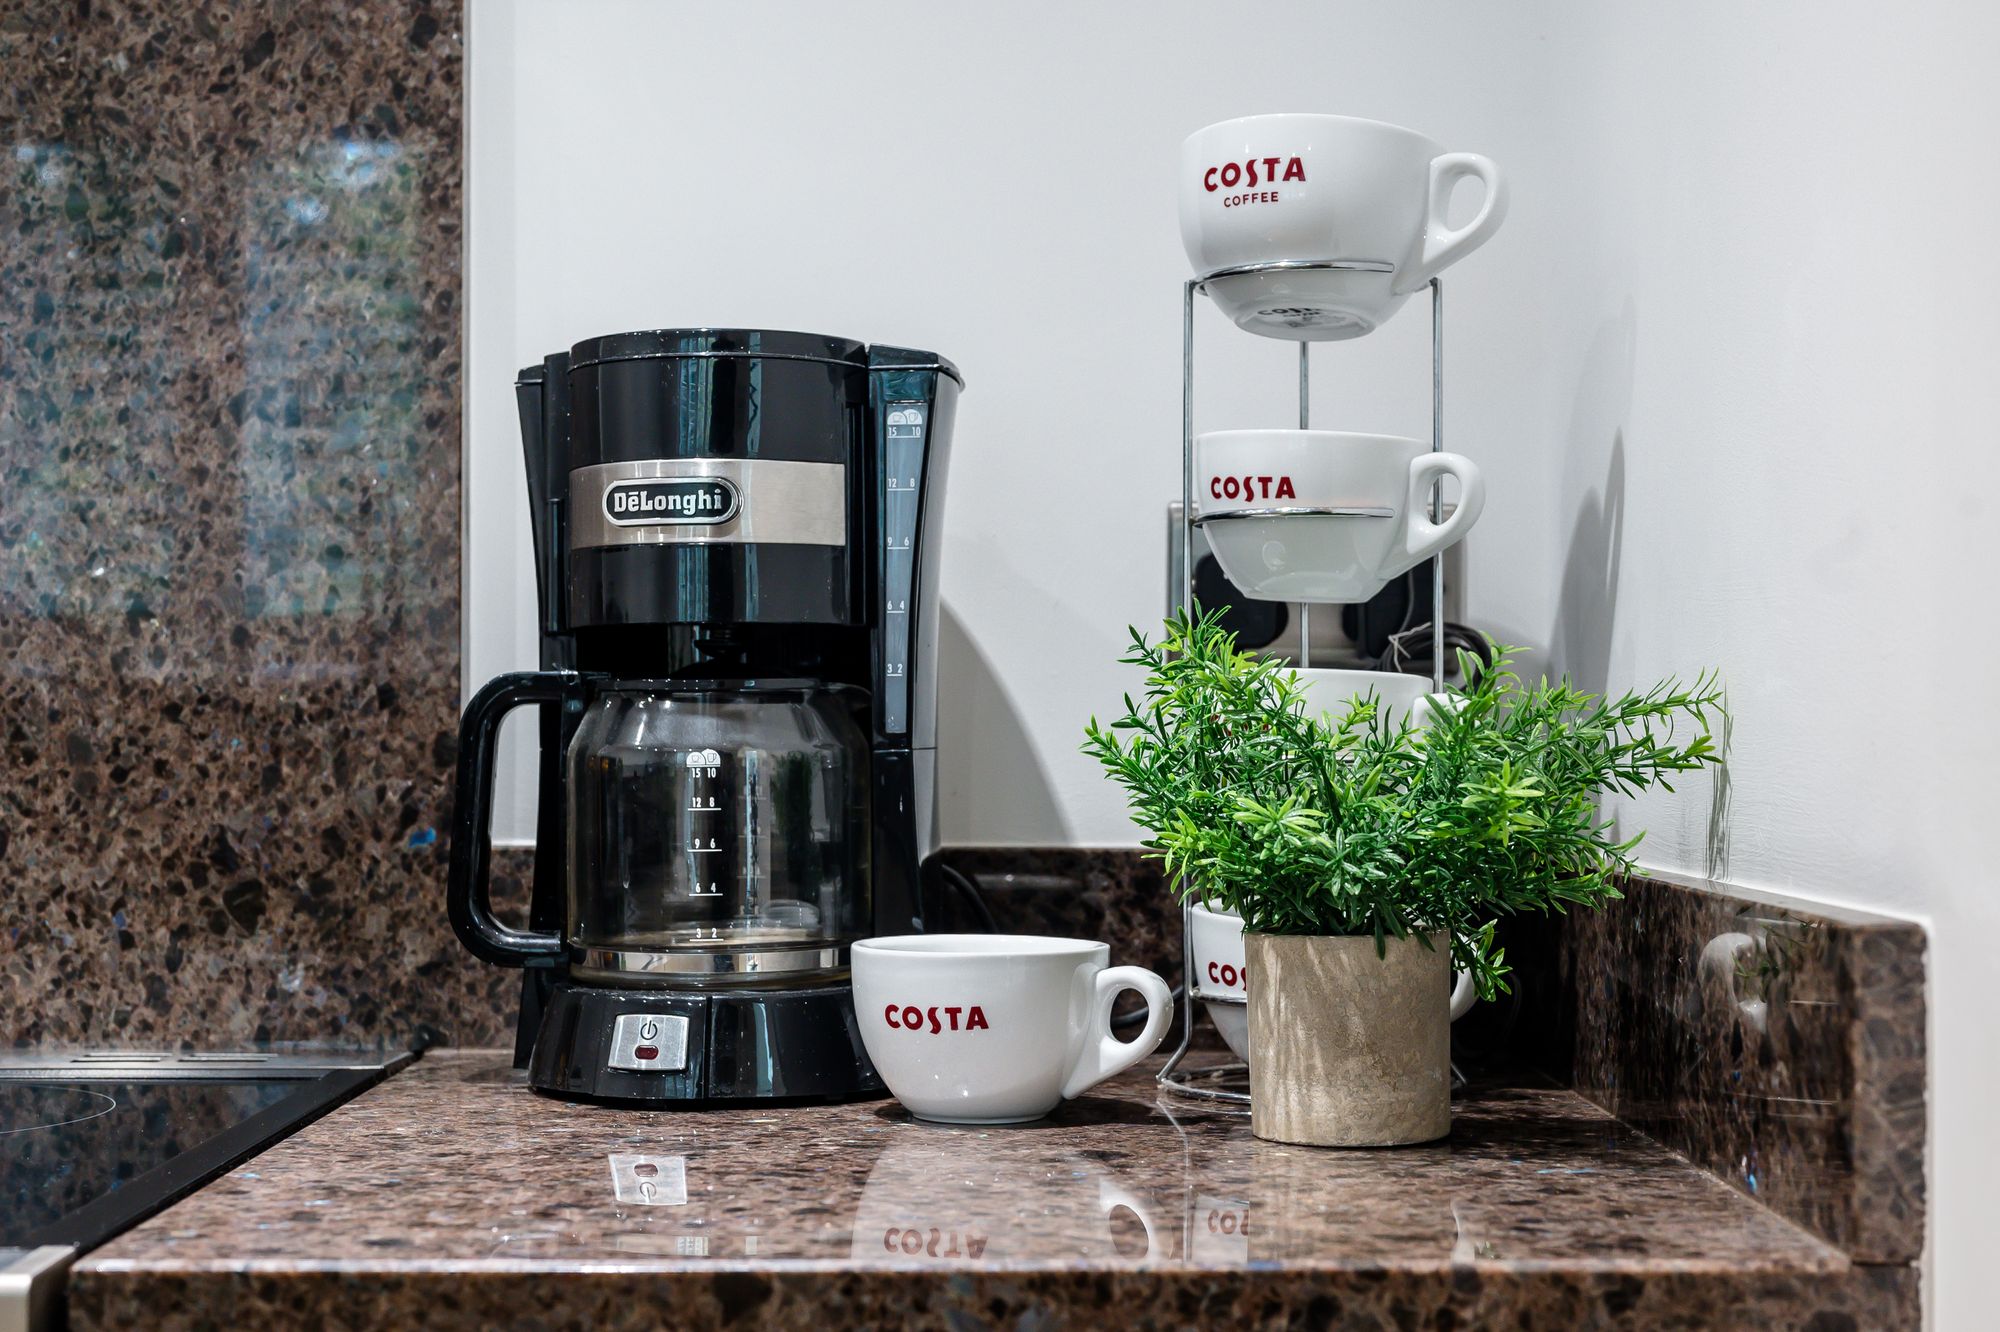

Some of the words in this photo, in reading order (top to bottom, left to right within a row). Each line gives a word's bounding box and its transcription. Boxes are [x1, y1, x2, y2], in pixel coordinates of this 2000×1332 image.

[1203, 156, 1307, 193] COSTA
[1223, 191, 1280, 208] COFFEE
[887, 426, 897, 436] 15
[911, 426, 921, 436] 10
[887, 478, 897, 488] 12
[909, 477, 916, 488] 8
[1210, 475, 1297, 503] COSTA
[887, 536, 893, 547] 9
[903, 536, 910, 546] 6
[887, 600, 893, 610] 6
[899, 600, 905, 610] 4
[887, 663, 893, 673] 3
[897, 663, 903, 673] 2
[691, 767, 701, 778] 15
[707, 767, 717, 778] 10
[691, 796, 702, 808] 12
[709, 796, 715, 808] 8
[694, 838, 700, 849] 9
[709, 838, 716, 849] 6
[695, 882, 701, 893] 6
[710, 882, 717, 893] 4
[695, 927, 702, 939] 3
[711, 927, 718, 938] 2
[1208, 960, 1247, 992] COS
[884, 1004, 990, 1035] COSTA
